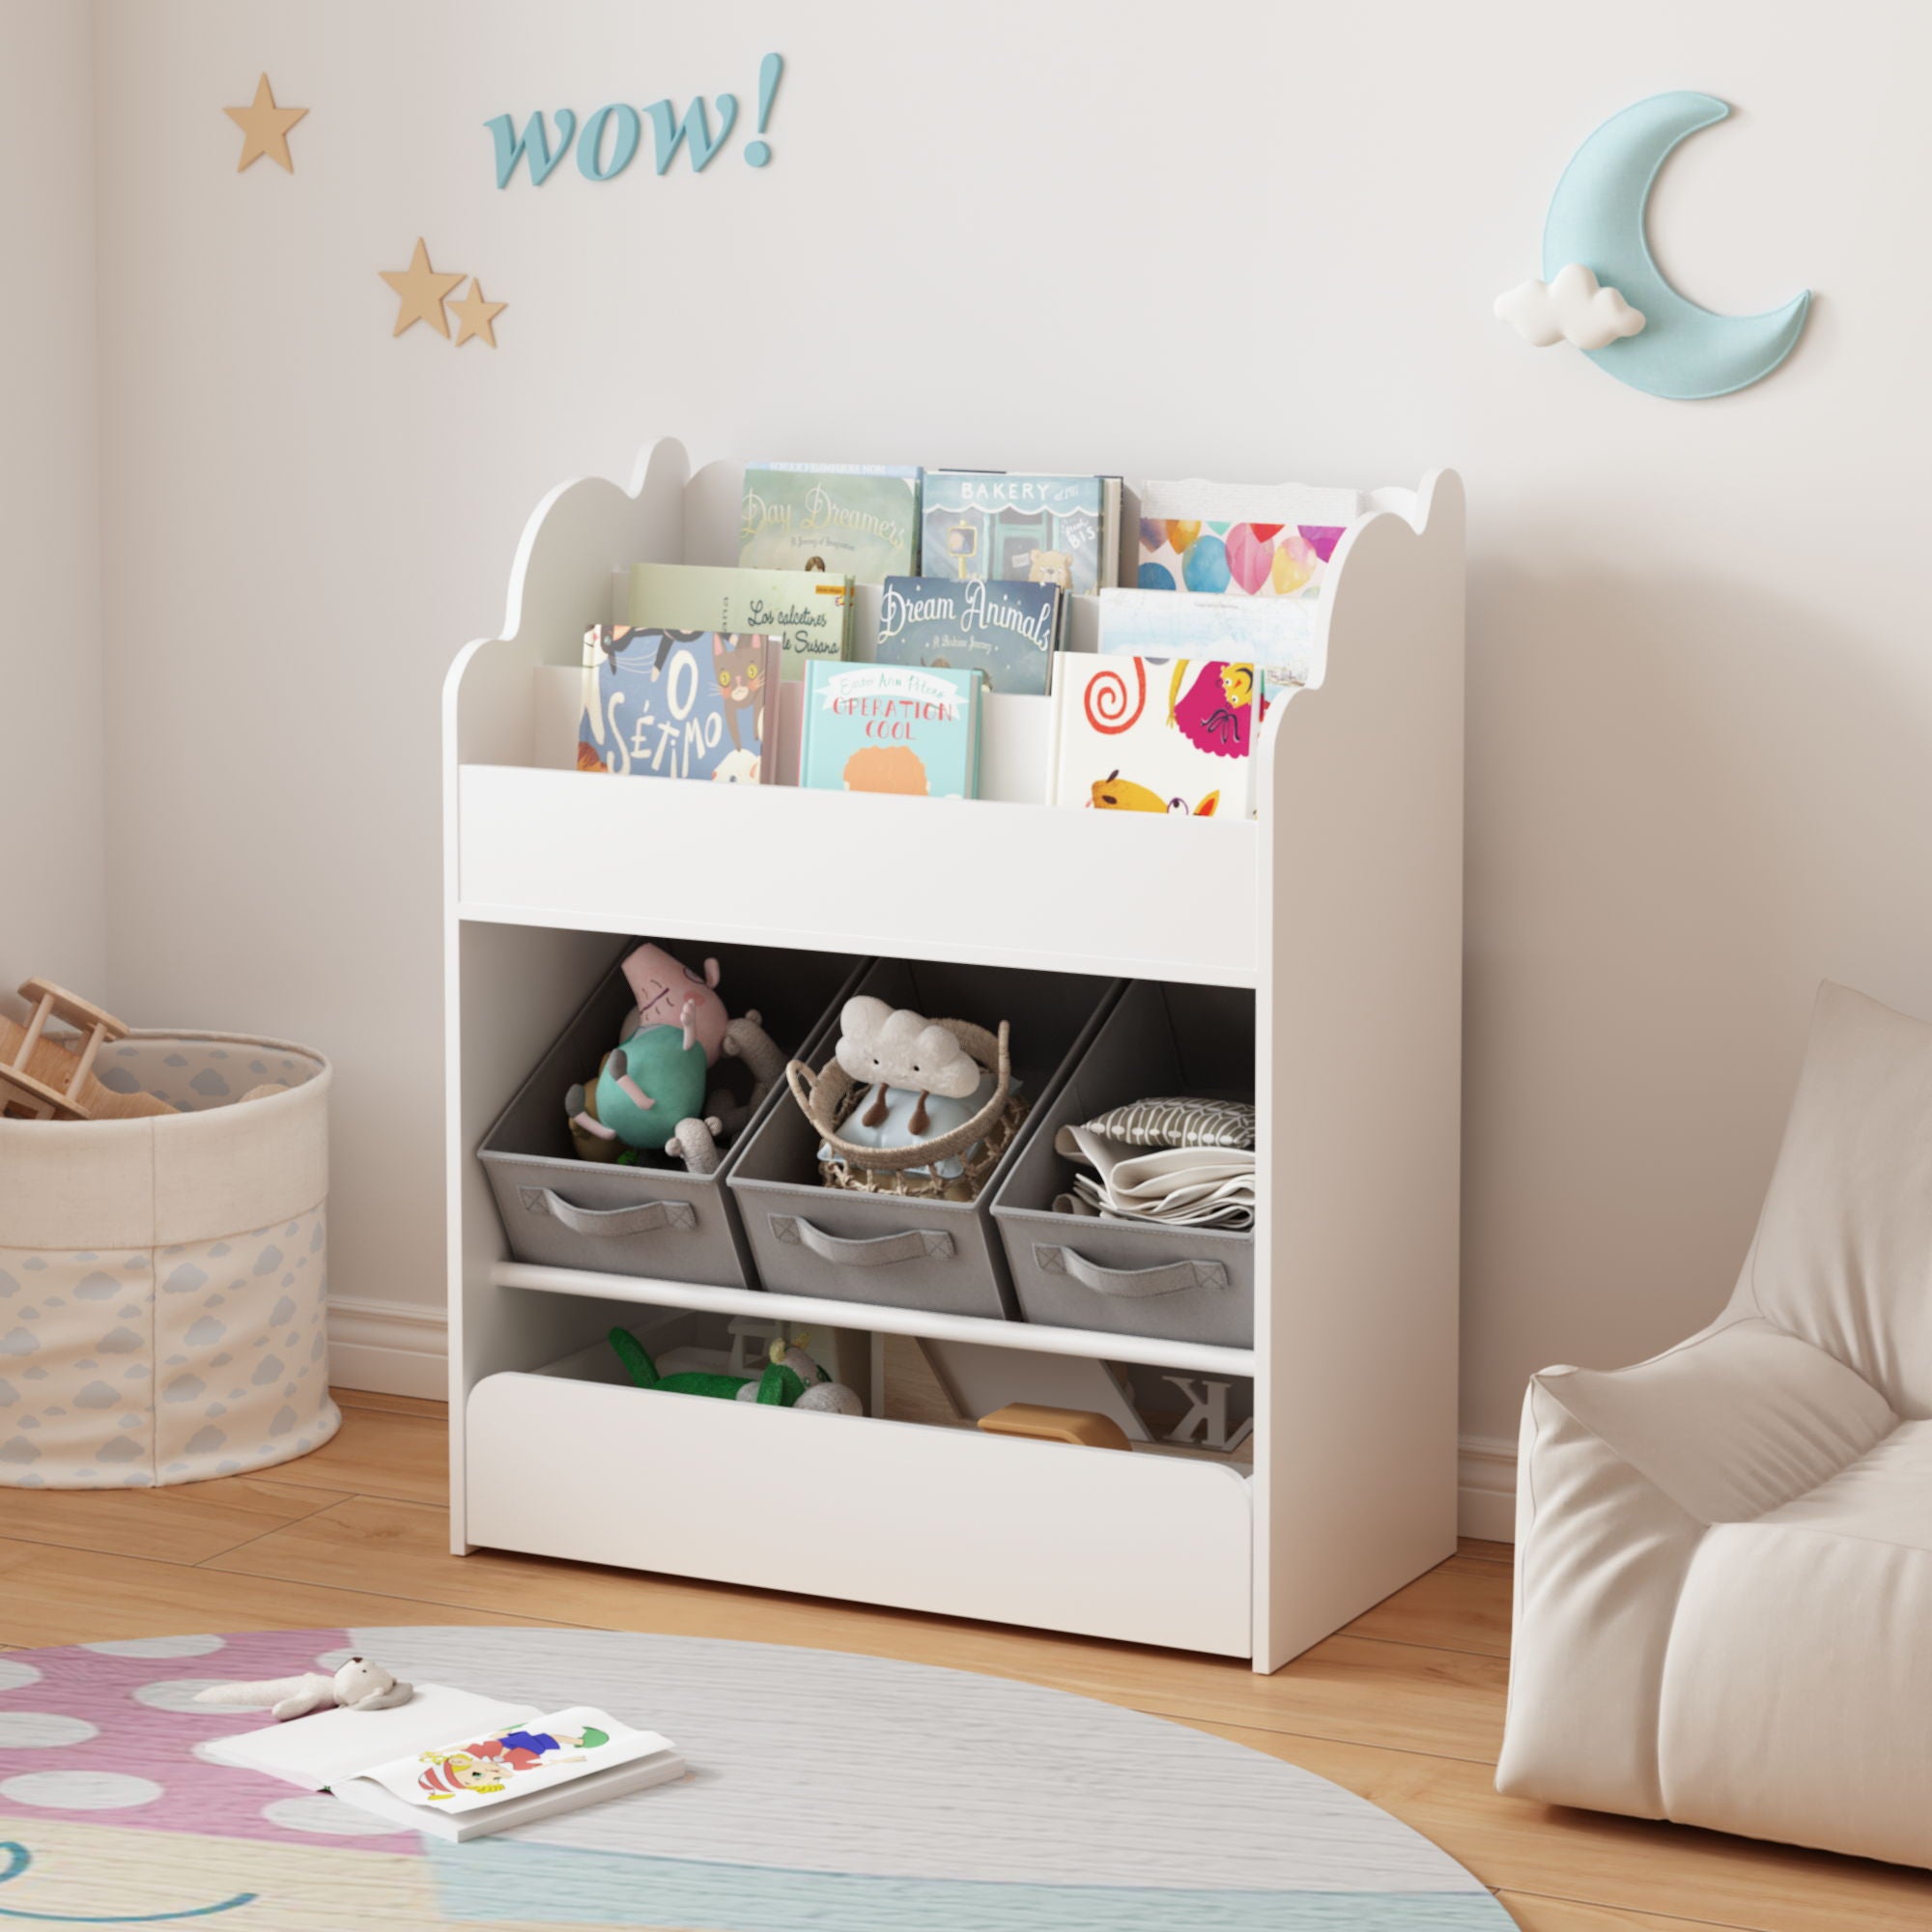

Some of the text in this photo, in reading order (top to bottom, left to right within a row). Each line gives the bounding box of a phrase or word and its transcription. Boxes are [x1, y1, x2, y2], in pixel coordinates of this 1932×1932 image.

[483, 51, 784, 189] wow!
[961, 481, 1050, 501] BAKERY
[740, 482, 905, 549] Day Dreamers
[748, 599, 774, 627] Los
[777, 604, 828, 628] calcetines
[878, 580, 1052, 652] Dream Animals
[794, 630, 839, 655] Susana
[667, 649, 698, 721] O
[832, 696, 952, 723] OPERATION
[865, 720, 918, 741] COOL
